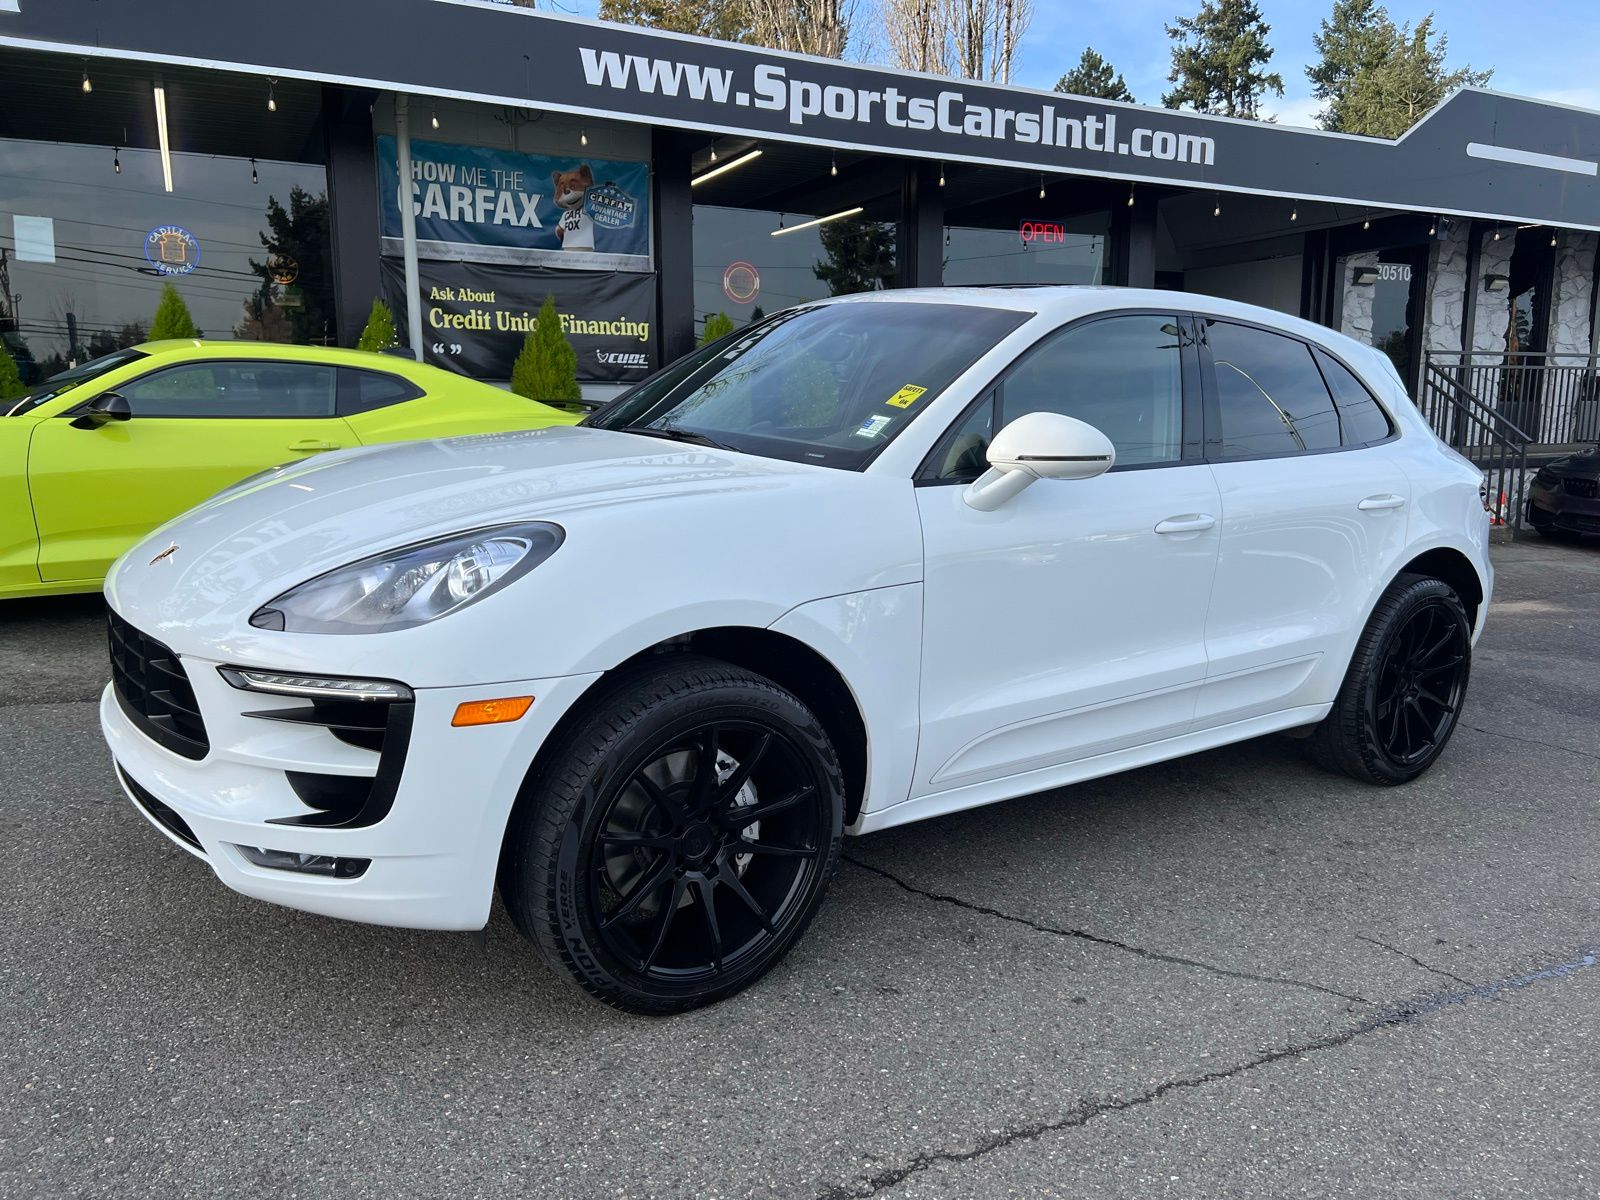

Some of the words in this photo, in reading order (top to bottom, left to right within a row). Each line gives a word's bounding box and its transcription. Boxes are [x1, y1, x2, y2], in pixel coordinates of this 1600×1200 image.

[396, 159, 456, 183] HOW
[461, 165, 488, 187] ME
[491, 169, 524, 191] THE
[589, 192, 633, 212] CARFAX
[590, 203, 628, 220] ADVANTAGE
[564, 219, 580, 231] FOX
[594, 212, 620, 227] DEALER
[149, 226, 195, 247] CADILLAC
[1021, 222, 1064, 243] OPEN
[156, 261, 193, 275] SERVICE
[430, 286, 455, 301] Ask
[458, 288, 496, 303] About
[429, 307, 491, 330] Credit
[496, 311, 540, 332] Unio
[558, 314, 649, 341] Financing
[560, 868, 574, 930] VERDE
